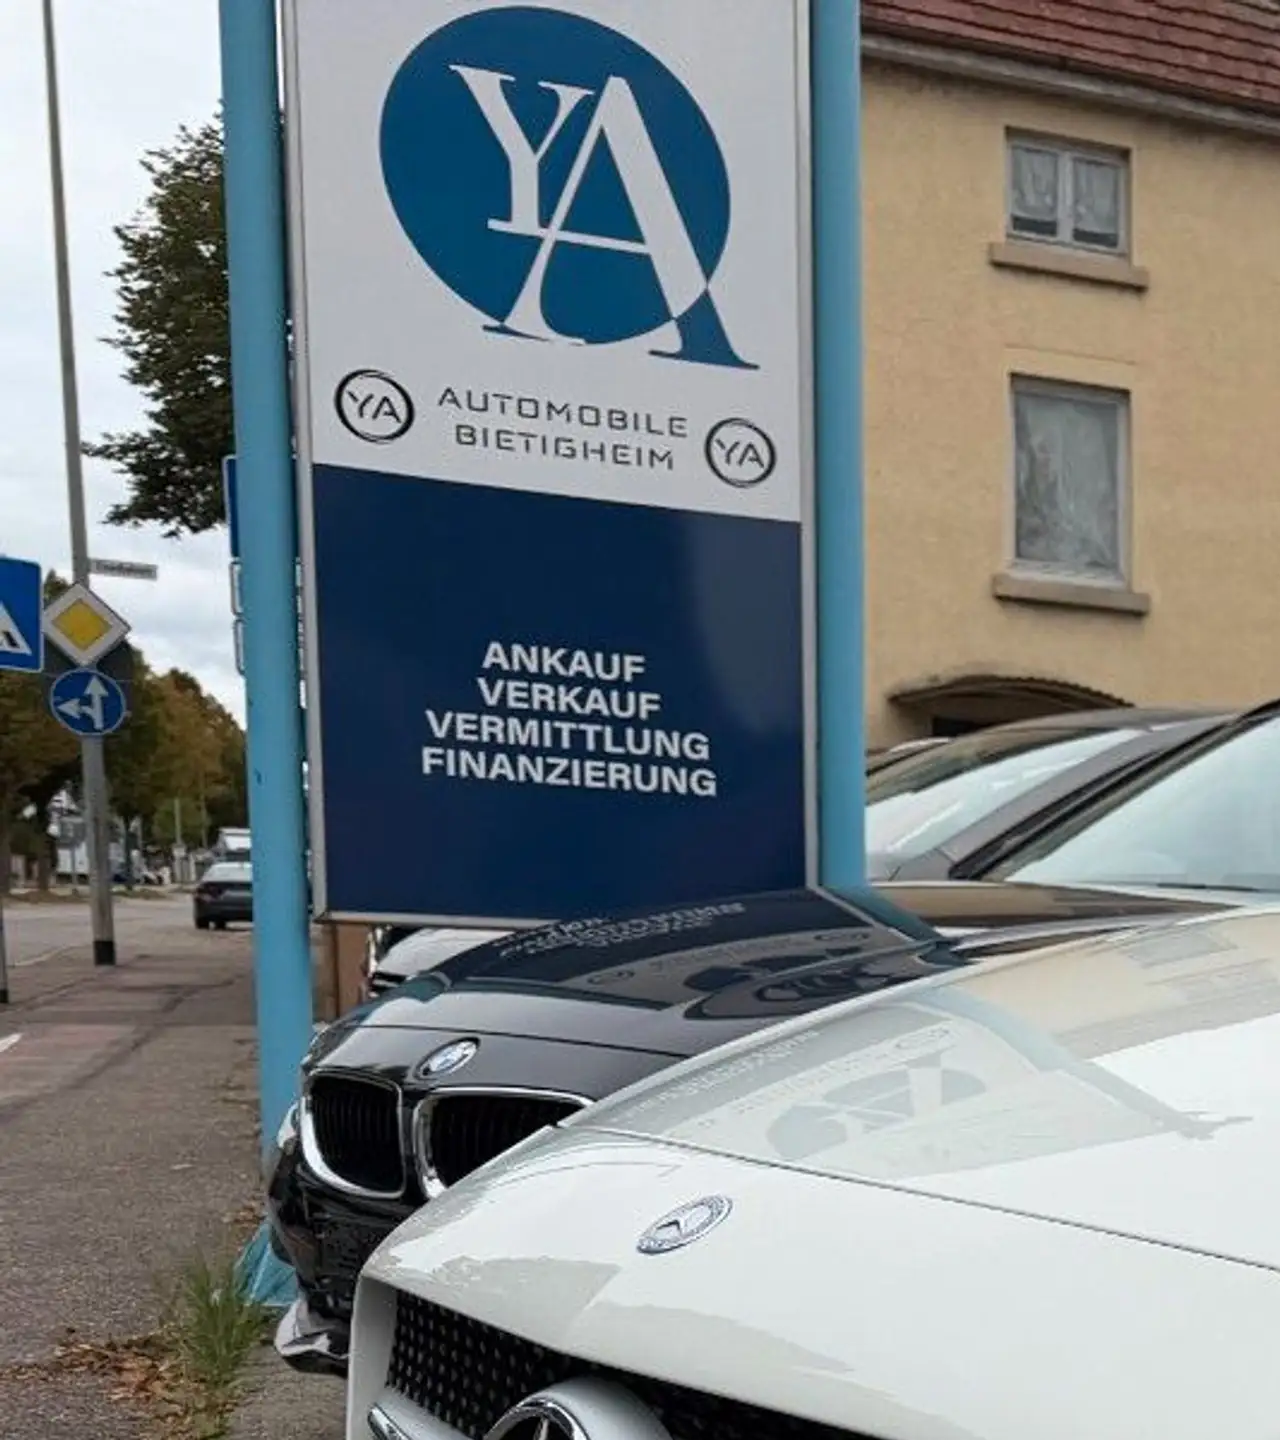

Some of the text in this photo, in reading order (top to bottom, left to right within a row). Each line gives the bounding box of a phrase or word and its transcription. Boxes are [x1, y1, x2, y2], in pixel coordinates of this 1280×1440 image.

[346, 390, 402, 424] YA
[437, 386, 689, 439] AUTOMOBILE
[454, 423, 675, 470] BIETIGHEIM
[715, 436, 766, 470] YA
[481, 640, 646, 683] ANKAUF
[476, 676, 661, 721] VERKAUF
[424, 708, 711, 761] VERMITTLUNG
[421, 745, 718, 798] FINANZIERUNG
